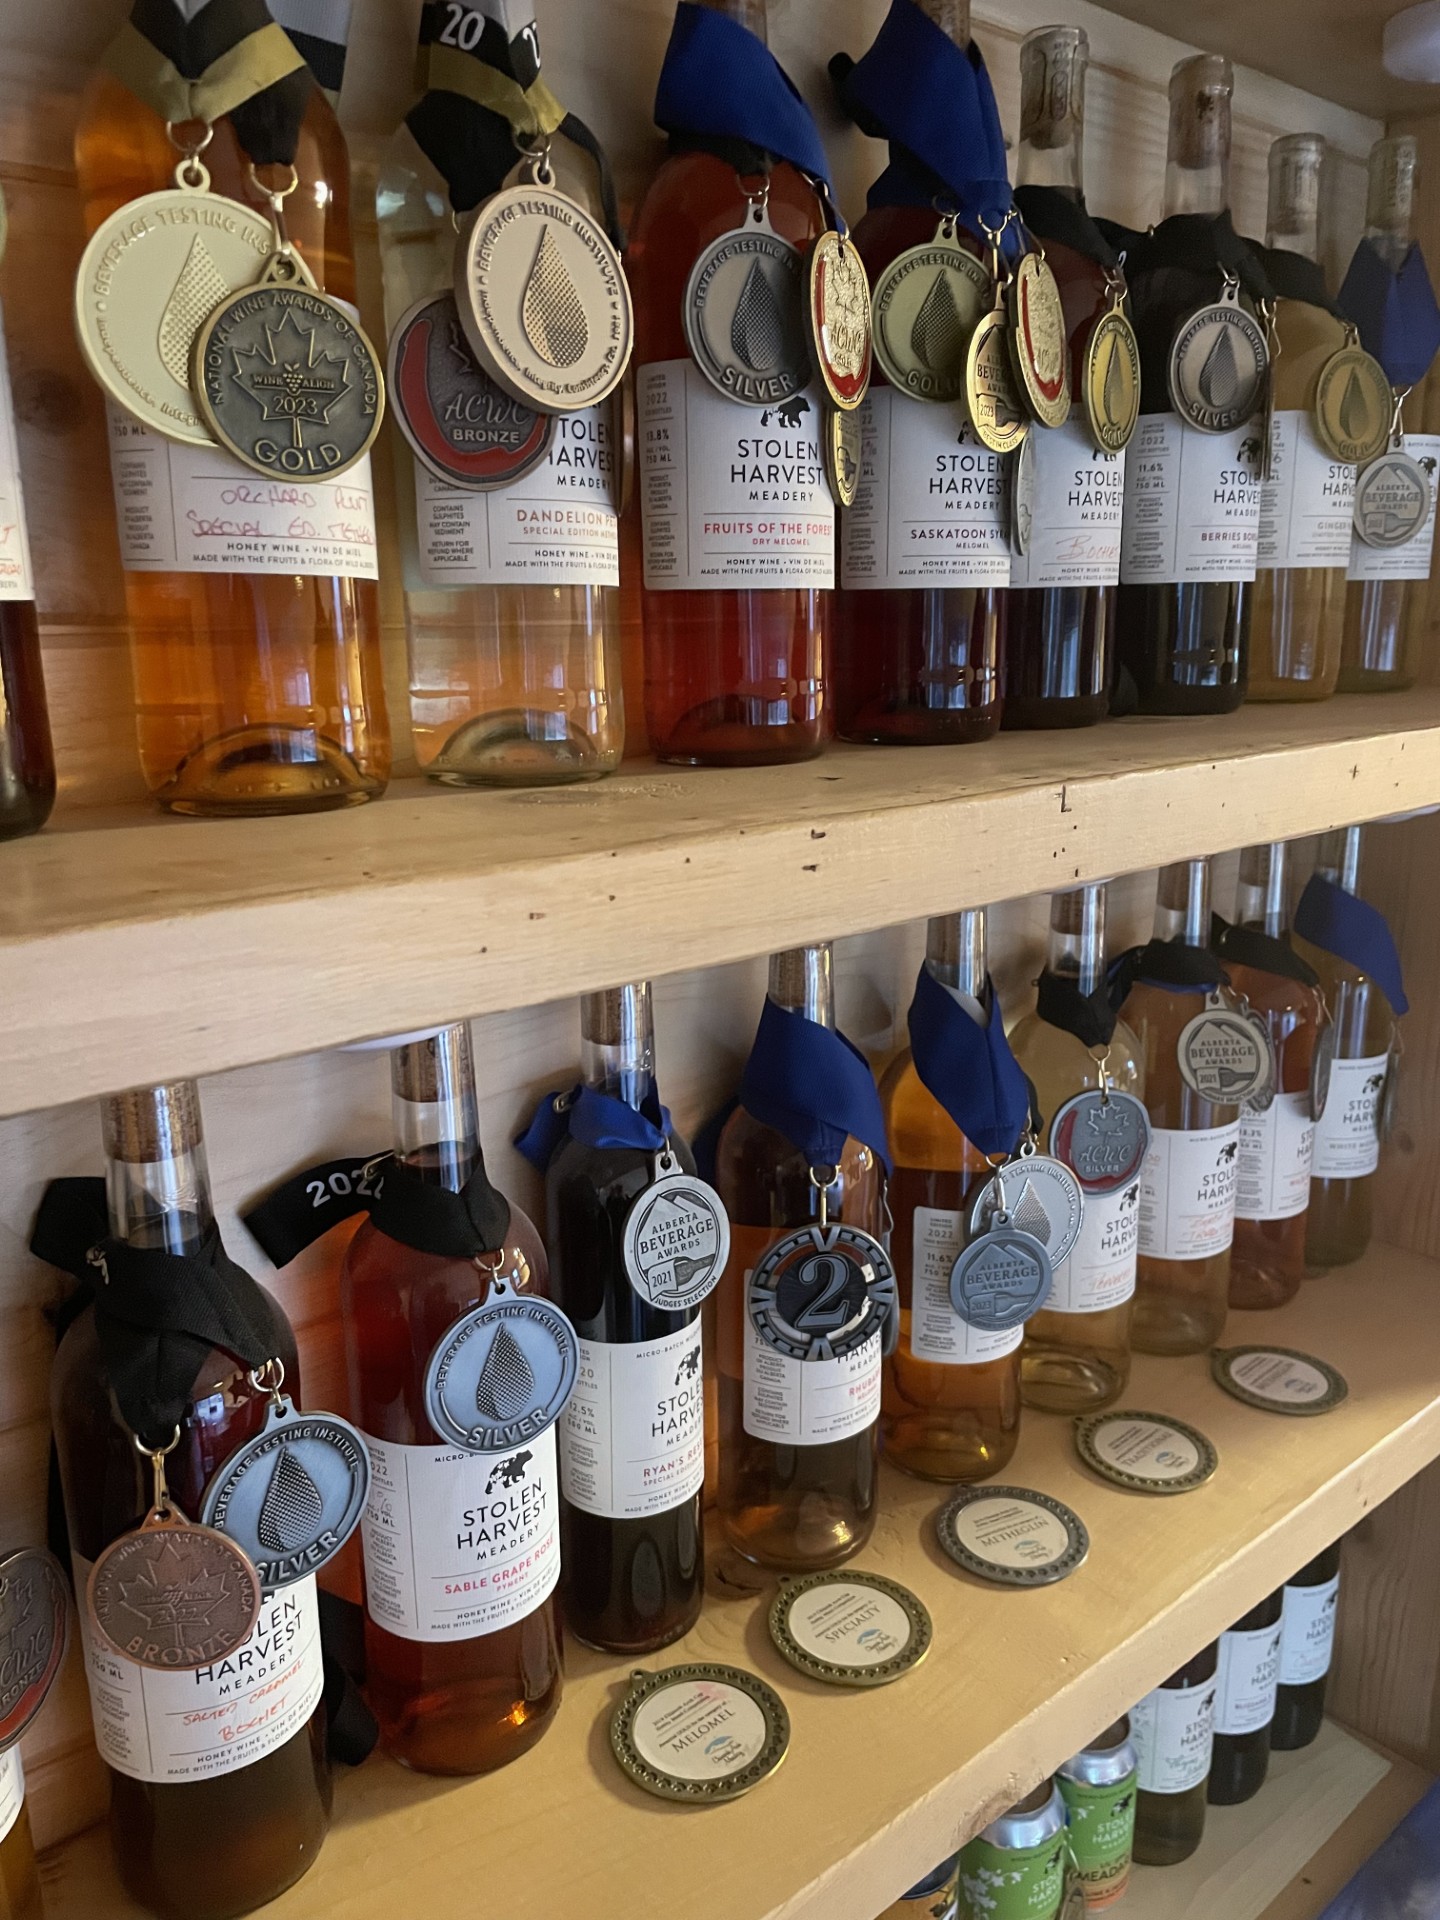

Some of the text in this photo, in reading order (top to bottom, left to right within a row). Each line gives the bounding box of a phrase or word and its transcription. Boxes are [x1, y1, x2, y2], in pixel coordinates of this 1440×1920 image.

[440, 4, 486, 50] 20
[518, 200, 575, 228] TESTING
[93, 206, 237, 297] BEVERAGE TESTING
[695, 240, 781, 308] BEVERAGE TESTING
[879, 253, 968, 311] BEVERAGE TESTING
[1210, 310, 1266, 373] TESTING INSTITUTE
[207, 294, 376, 416] NATIONAL WINE AWARDS OF CANADA
[252, 374, 337, 390] WINE ALIGN
[721, 367, 794, 398] SILVER
[274, 395, 319, 416] 2023
[1188, 402, 1238, 428] SILVER
[131, 425, 147, 437] ML
[453, 428, 521, 444] BRONZE
[1140, 436, 1165, 446] 2022
[254, 438, 342, 471] GOLD
[738, 439, 818, 460] STOLEN
[936, 455, 1005, 473] STOLEN
[1138, 463, 1164, 473] 11.6%
[731, 464, 823, 486] HARVEST
[750, 491, 814, 502] MEADERY
[1365, 492, 1421, 503] BEVERAGE
[517, 510, 602, 525] DANDELION
[523, 527, 599, 537] SPECIAL EDITION
[704, 523, 802, 534] FRUITS OF THE
[911, 529, 986, 539] SASKATOON
[1201, 532, 1241, 541] BERRIES
[227, 542, 301, 553] HONEY WINE
[752, 538, 770, 546] DRY
[193, 554, 299, 565] MADE WITH THE FRUITS
[505, 560, 528, 568] MADE
[535, 550, 589, 559] HONEY WINE
[1190, 1046, 1255, 1058] BEVERAGE
[1200, 1039, 1241, 1047] ALBERTA
[1204, 1057, 1243, 1066] AWARDS
[1199, 1073, 1218, 1084] 2021
[1085, 1164, 1120, 1173] SILVER
[651, 1212, 699, 1235] ALBERTA
[928, 1228, 953, 1239] 2022
[639, 1218, 715, 1255] BEVERAGE
[656, 1238, 702, 1261] AWARDS
[979, 1260, 1025, 1271] ALBERTA
[651, 1270, 673, 1288] 2021
[966, 1266, 1039, 1286] BEVERAGE
[981, 1280, 1024, 1291] AWARDS
[683, 1275, 718, 1306] SELECTION
[793, 1254, 851, 1329] 2
[437, 1305, 570, 1390] BEVERAGE TESTING INSTITUTE
[636, 1340, 685, 1359] MICRO-BATCH
[466, 1407, 548, 1447] SILVER
[585, 1426, 598, 1436] ML
[643, 1453, 684, 1478] RYAN'S
[214, 1425, 360, 1530] BEVERAGE TESTING INSTITUTE
[643, 1473, 674, 1487] SPECIAL
[463, 1477, 543, 1527] STOLEN
[648, 1483, 689, 1503] HONEY WINE
[644, 1503, 659, 1511] WITH
[382, 1517, 395, 1528] ML
[457, 1493, 547, 1549] HARVEST
[476, 1524, 540, 1561] MEADERY
[980, 1517, 1050, 1548] METHEGLIN
[255, 1530, 339, 1583] SILVER
[444, 1578, 487, 1595] SABLE
[492, 1558, 533, 1584] GRAPE
[496, 1573, 530, 1592] PYMENT
[229, 1560, 254, 1616] CANADA
[457, 1588, 532, 1620] HONEY WINE VIN
[453, 1620, 471, 1628] WITH
[472, 1616, 485, 1625] THE
[823, 1604, 882, 1644] SPECIALTY
[126, 1628, 235, 1665] BRONZE
[195, 1610, 302, 1685] HARVEST
[108, 1670, 125, 1681] ML
[219, 1648, 295, 1696] MEADERY
[671, 1707, 735, 1755] MELOMEL
[197, 1722, 287, 1763] HONEY WINE VIN
[167, 1767, 190, 1775] MADE
[193, 1763, 214, 1774] WITH
[216, 1758, 231, 1768] THE
[233, 1746, 259, 1765] FRUITS
